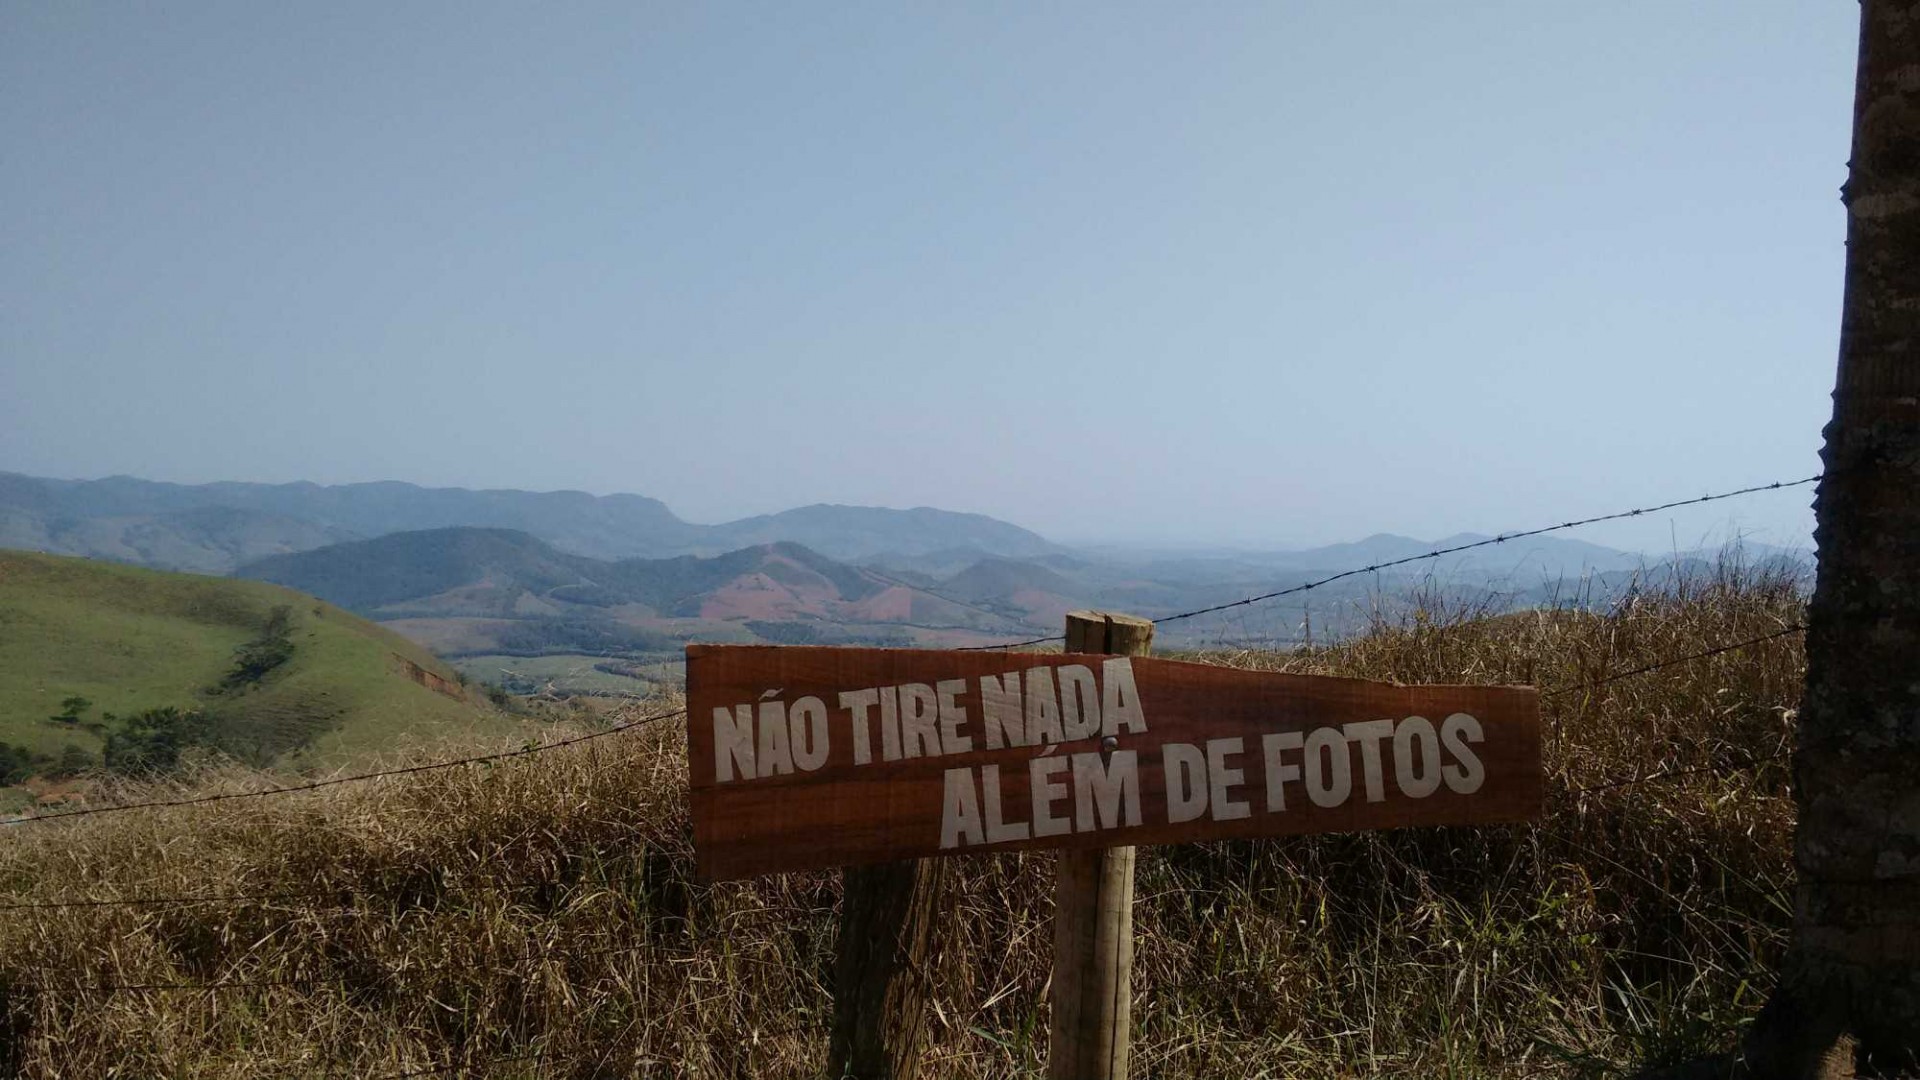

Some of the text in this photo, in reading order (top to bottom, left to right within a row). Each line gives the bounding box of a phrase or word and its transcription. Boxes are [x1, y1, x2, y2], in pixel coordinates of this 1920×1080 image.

[838, 678, 973, 766] TIRE
[980, 657, 1148, 751] NADA
[939, 712, 1486, 850] ALÉM DE FOTOS
